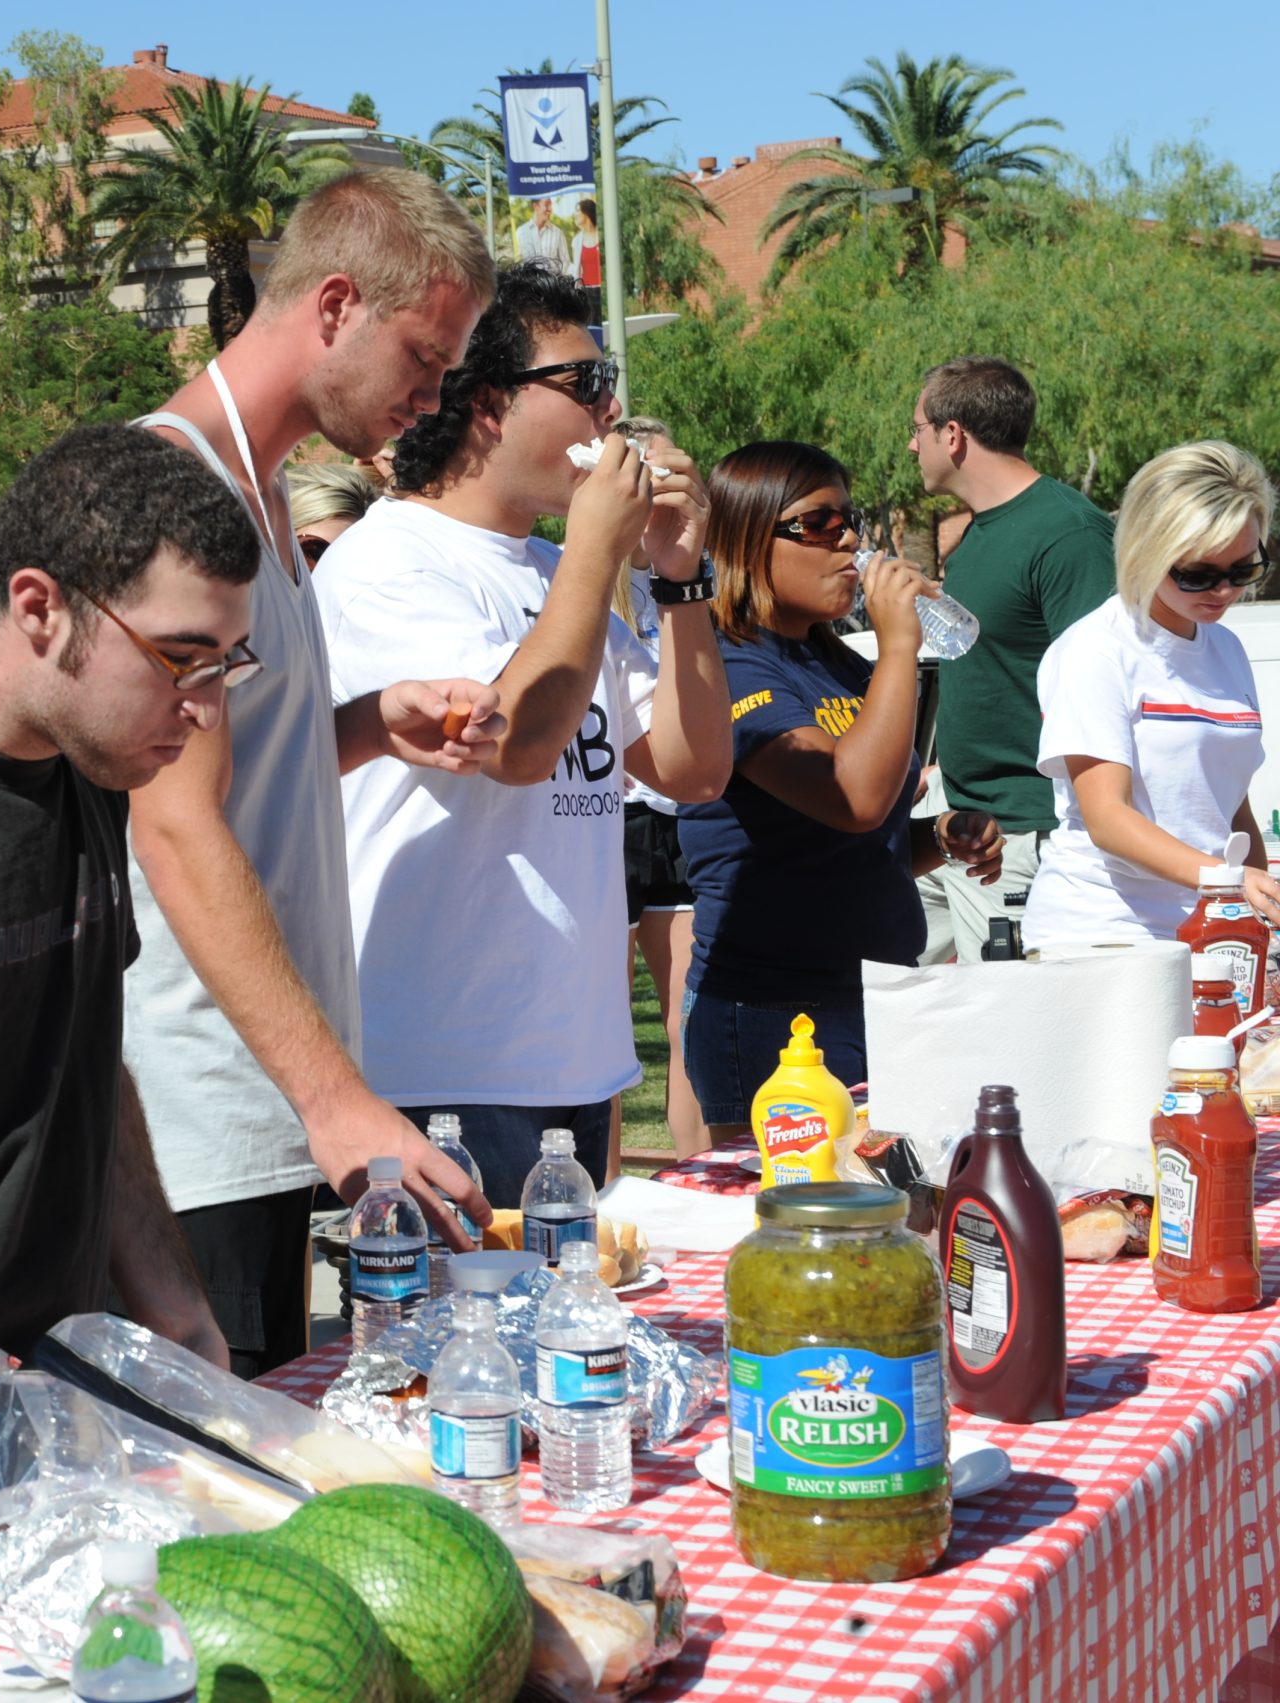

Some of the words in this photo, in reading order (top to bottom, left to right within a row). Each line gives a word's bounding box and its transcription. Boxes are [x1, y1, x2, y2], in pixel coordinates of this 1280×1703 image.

[546, 164, 571, 174] official
[520, 176, 545, 184] campus
[731, 689, 773, 724] CKEYE
[766, 1120, 823, 1147] French's
[1160, 1183, 1184, 1200] TOMATO
[1160, 1194, 1186, 1211] KETCHUP
[360, 1255, 415, 1268] KIRKLAND
[587, 1351, 626, 1368] KIRKL
[799, 1394, 871, 1413] vlasic
[779, 1416, 888, 1447] RELISH
[786, 1476, 835, 1494] FANCY
[838, 1478, 889, 1494] SWEET
